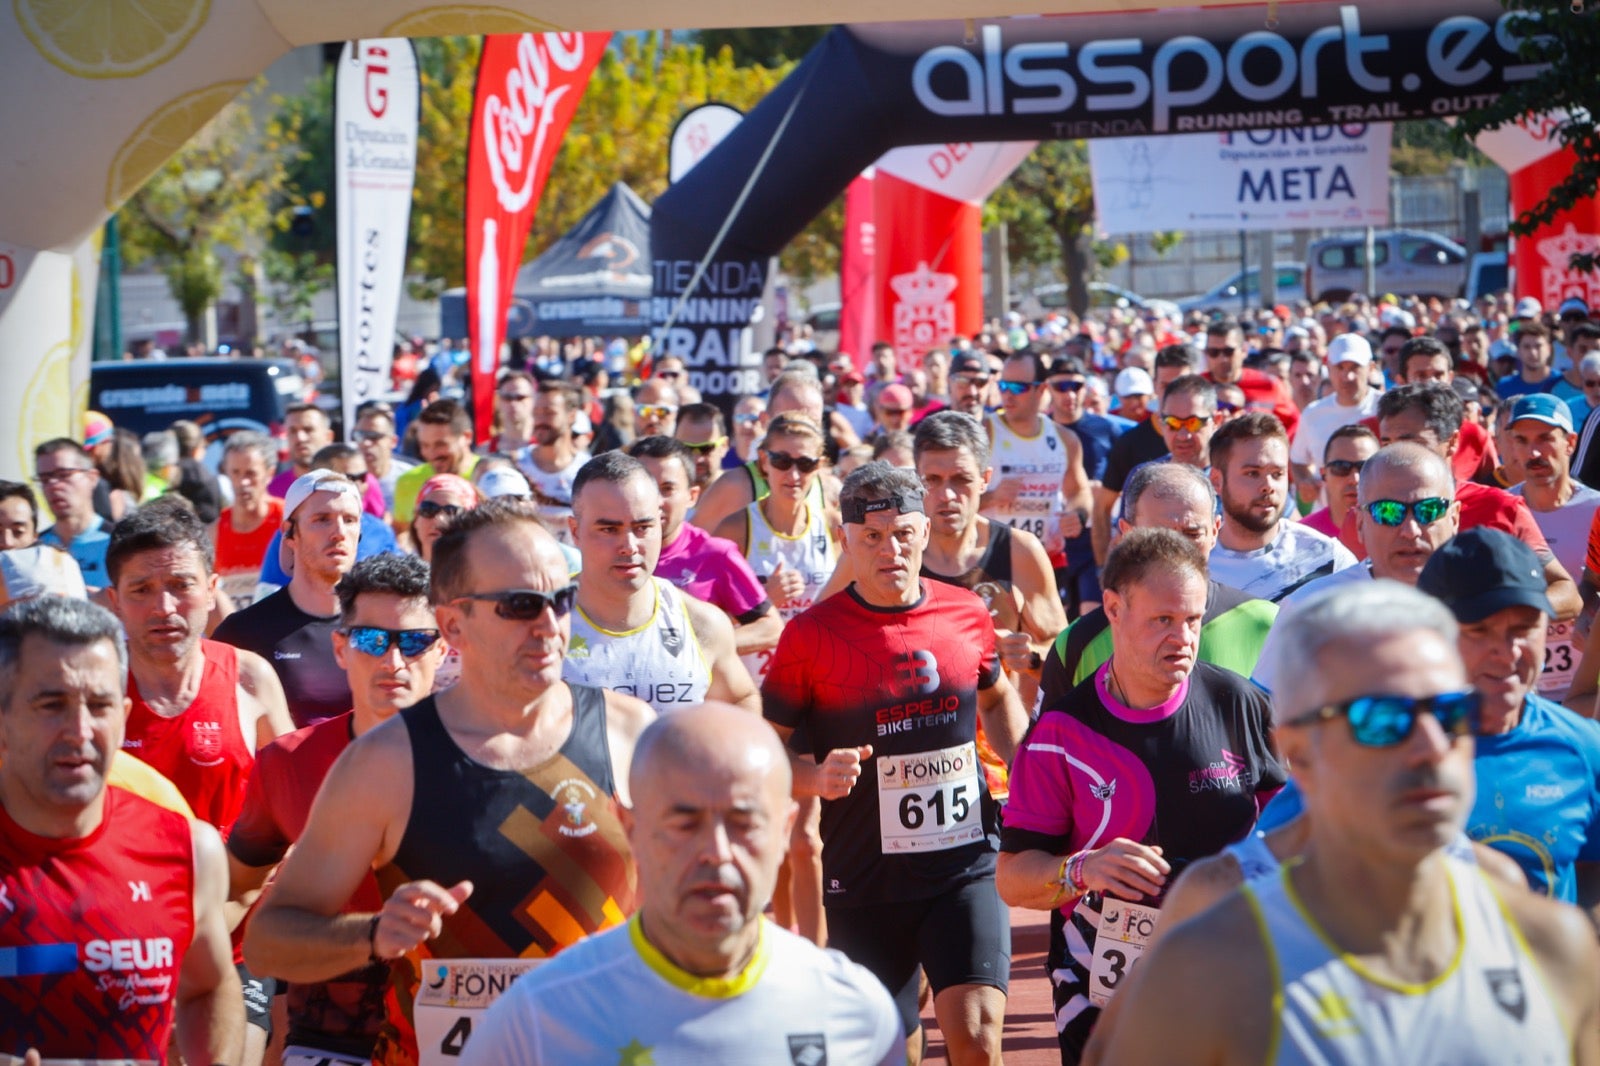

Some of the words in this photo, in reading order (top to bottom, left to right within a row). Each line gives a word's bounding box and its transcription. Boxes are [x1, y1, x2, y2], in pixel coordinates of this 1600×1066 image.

[912, 5, 1560, 132] alssport.es
[1051, 118, 1147, 138] TIENDA
[1177, 108, 1303, 131] RUNNING
[1328, 102, 1406, 121] TRAIL
[1431, 94, 1501, 115] OUT
[1238, 164, 1356, 203] META
[653, 260, 763, 295] TIENDA
[354, 229, 381, 398] eportes
[652, 297, 765, 324] RUNNING
[651, 327, 763, 367] TRAIL
[690, 369, 761, 395] DOOR
[875, 694, 960, 724] ESPEJO
[904, 757, 963, 779] FONDO
[1189, 775, 1235, 794] SANTA
[899, 784, 970, 830] 615
[1126, 915, 1154, 937] FO
[84, 937, 174, 972] SEUR
[1098, 949, 1139, 990] 3
